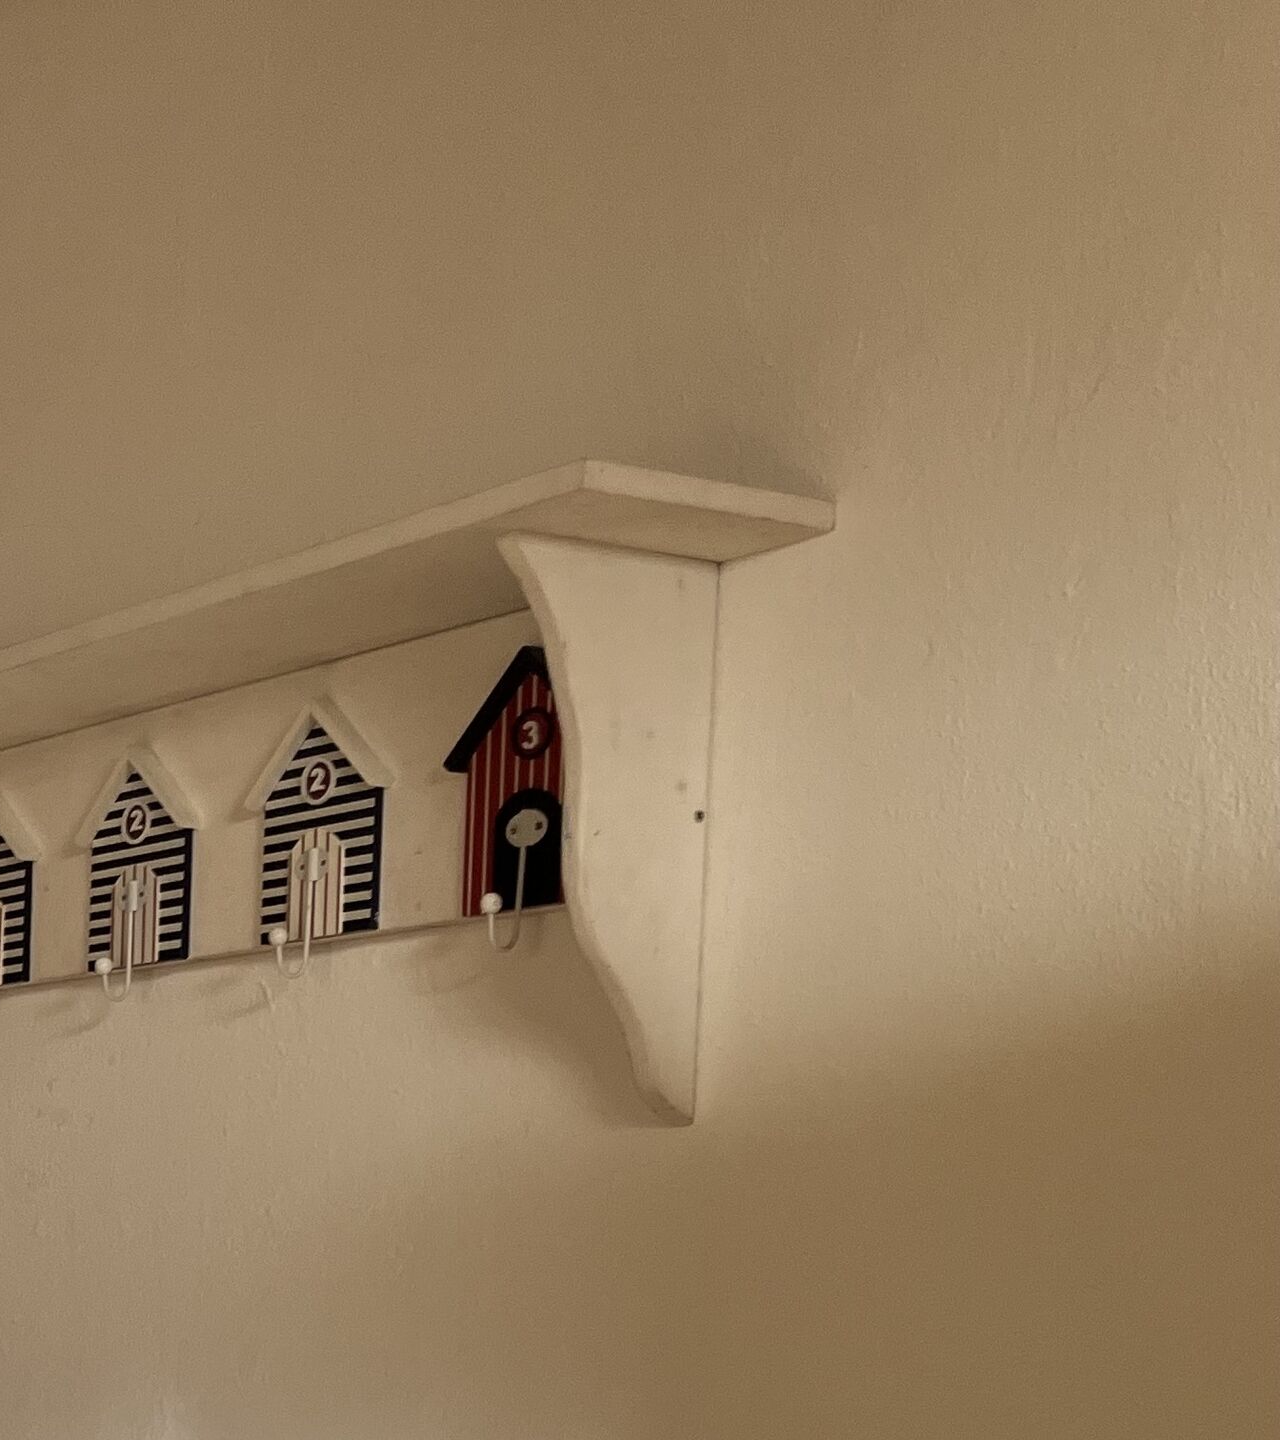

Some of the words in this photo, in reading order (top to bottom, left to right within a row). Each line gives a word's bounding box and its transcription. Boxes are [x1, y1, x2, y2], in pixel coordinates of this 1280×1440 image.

[521, 720, 539, 750] 3
[309, 767, 326, 793] 2
[129, 810, 143, 832] 2
